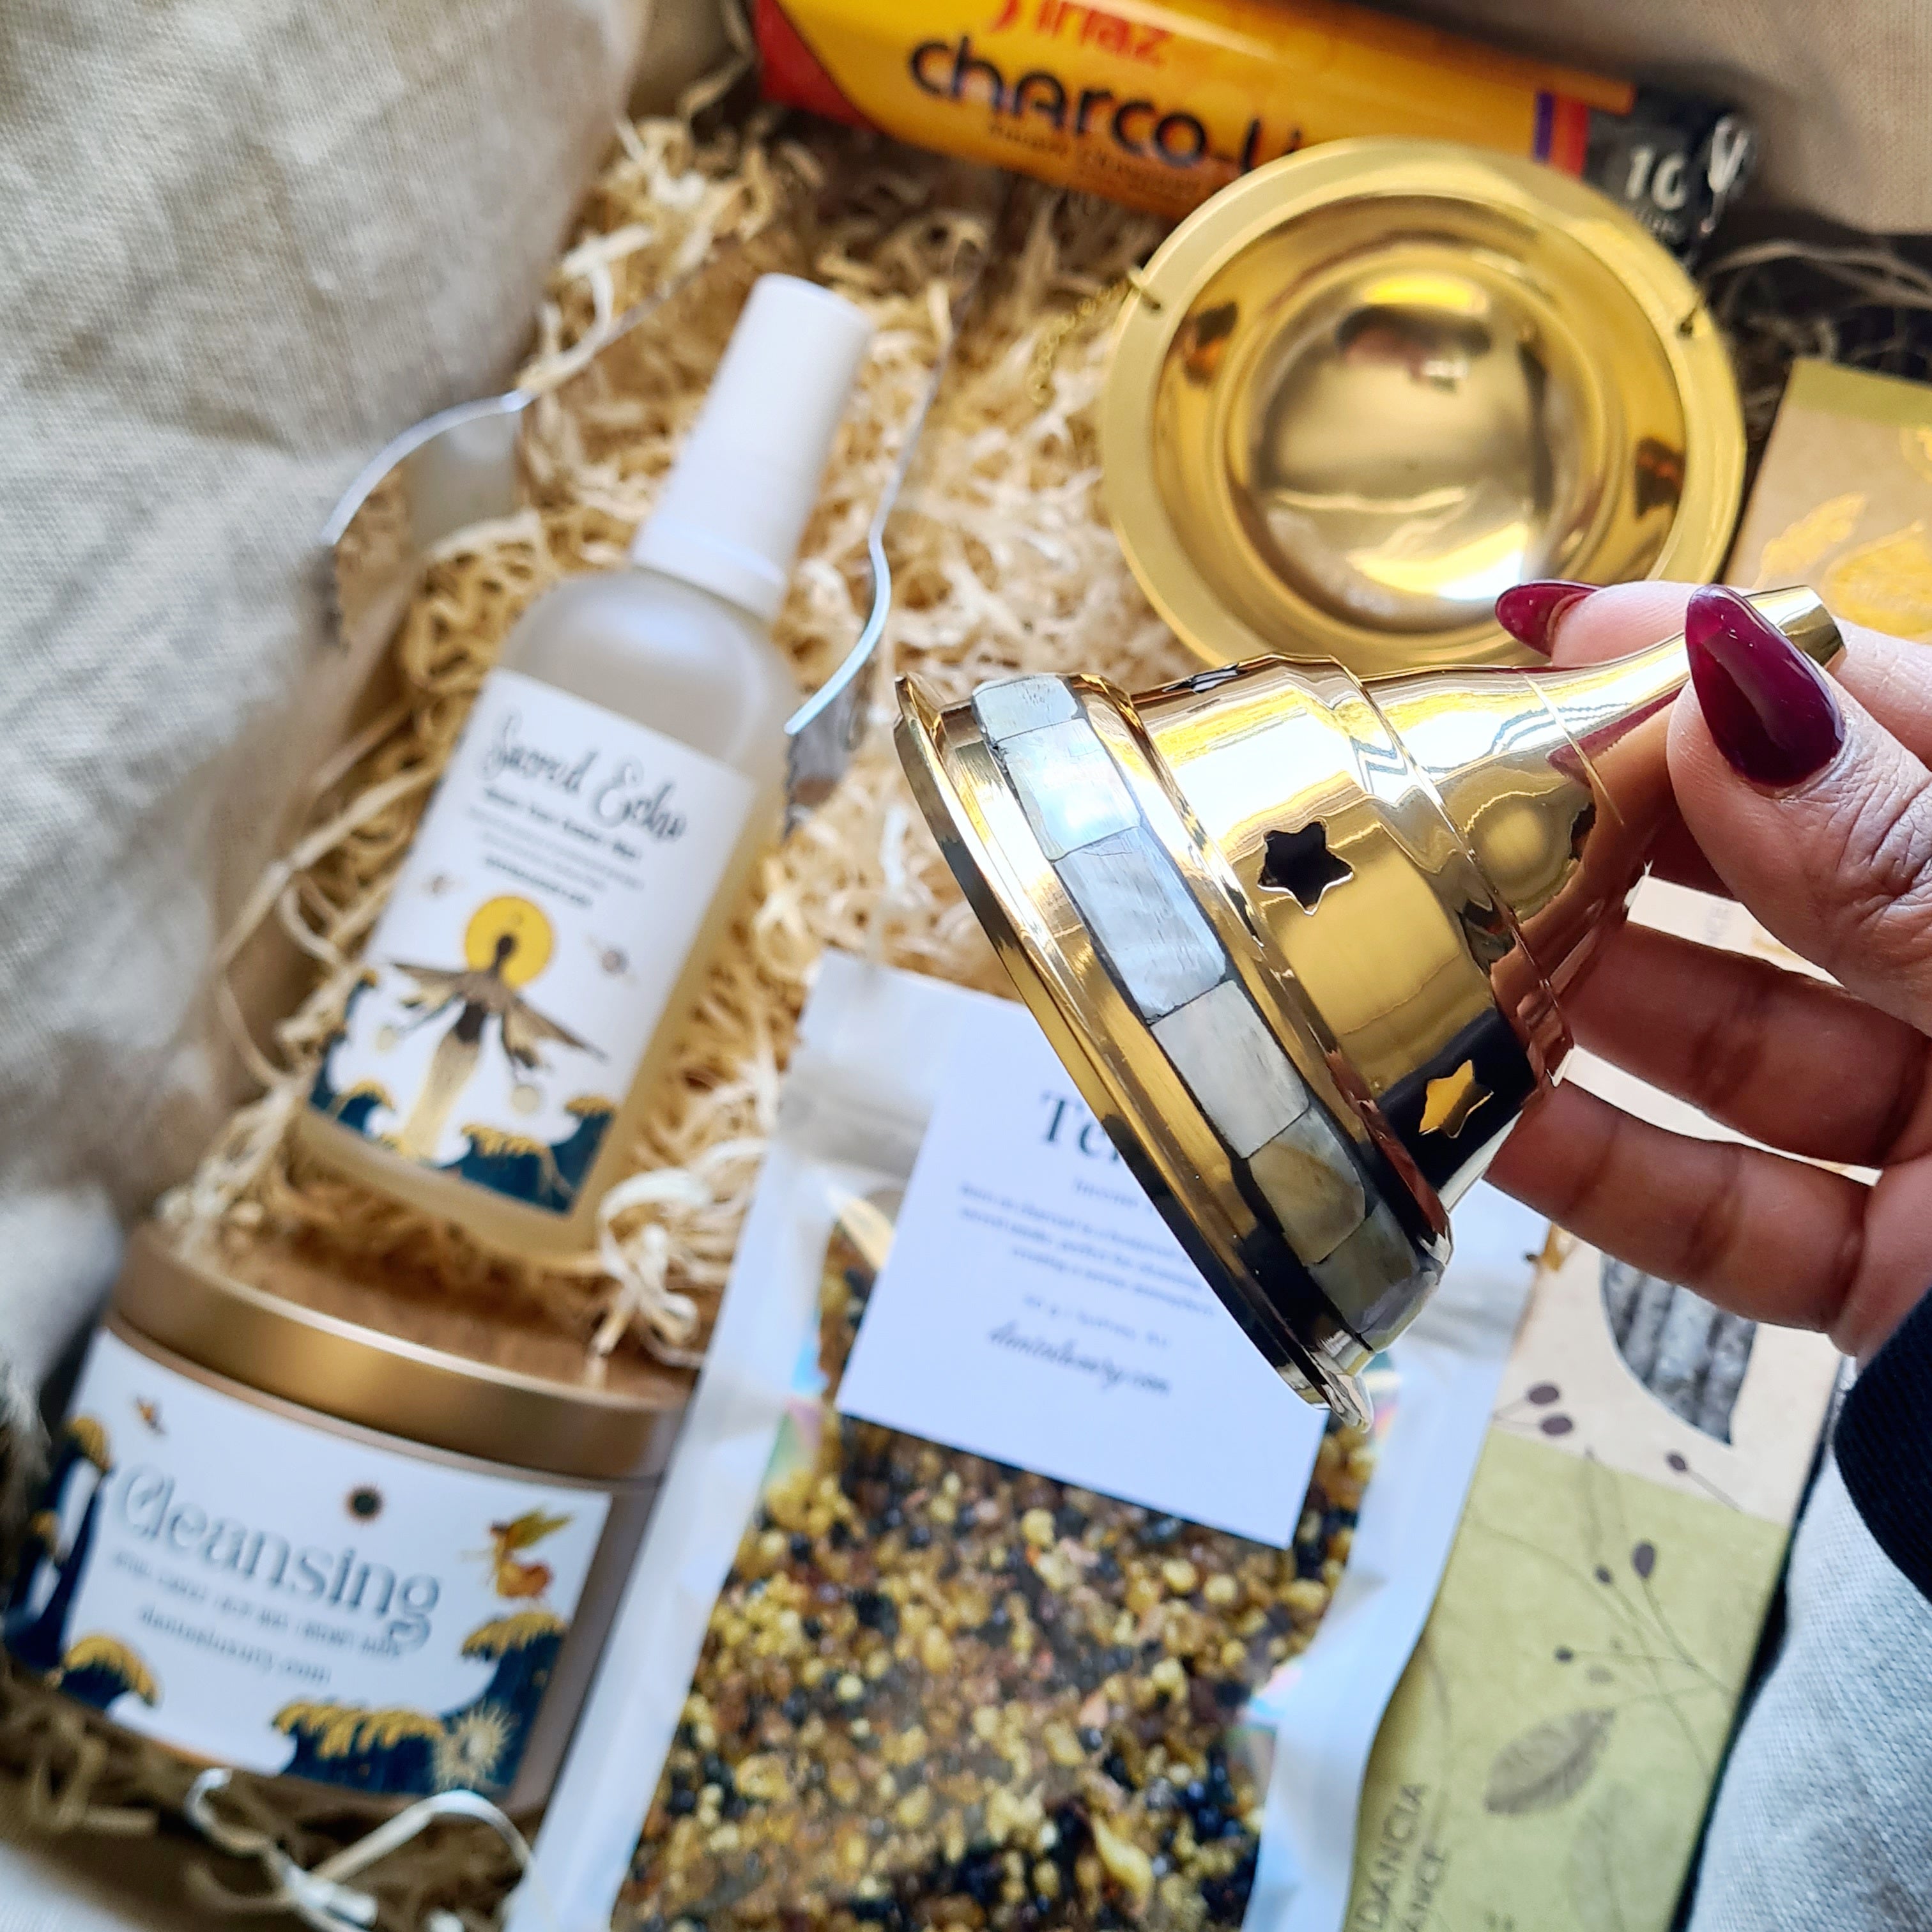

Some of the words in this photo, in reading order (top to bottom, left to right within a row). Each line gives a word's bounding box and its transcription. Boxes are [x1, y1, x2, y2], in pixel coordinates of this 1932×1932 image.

[1039, 1089, 1119, 1163] Te
[114, 1468, 442, 1650] Cleansing
[1351, 1784, 1425, 1932] DANCIA
